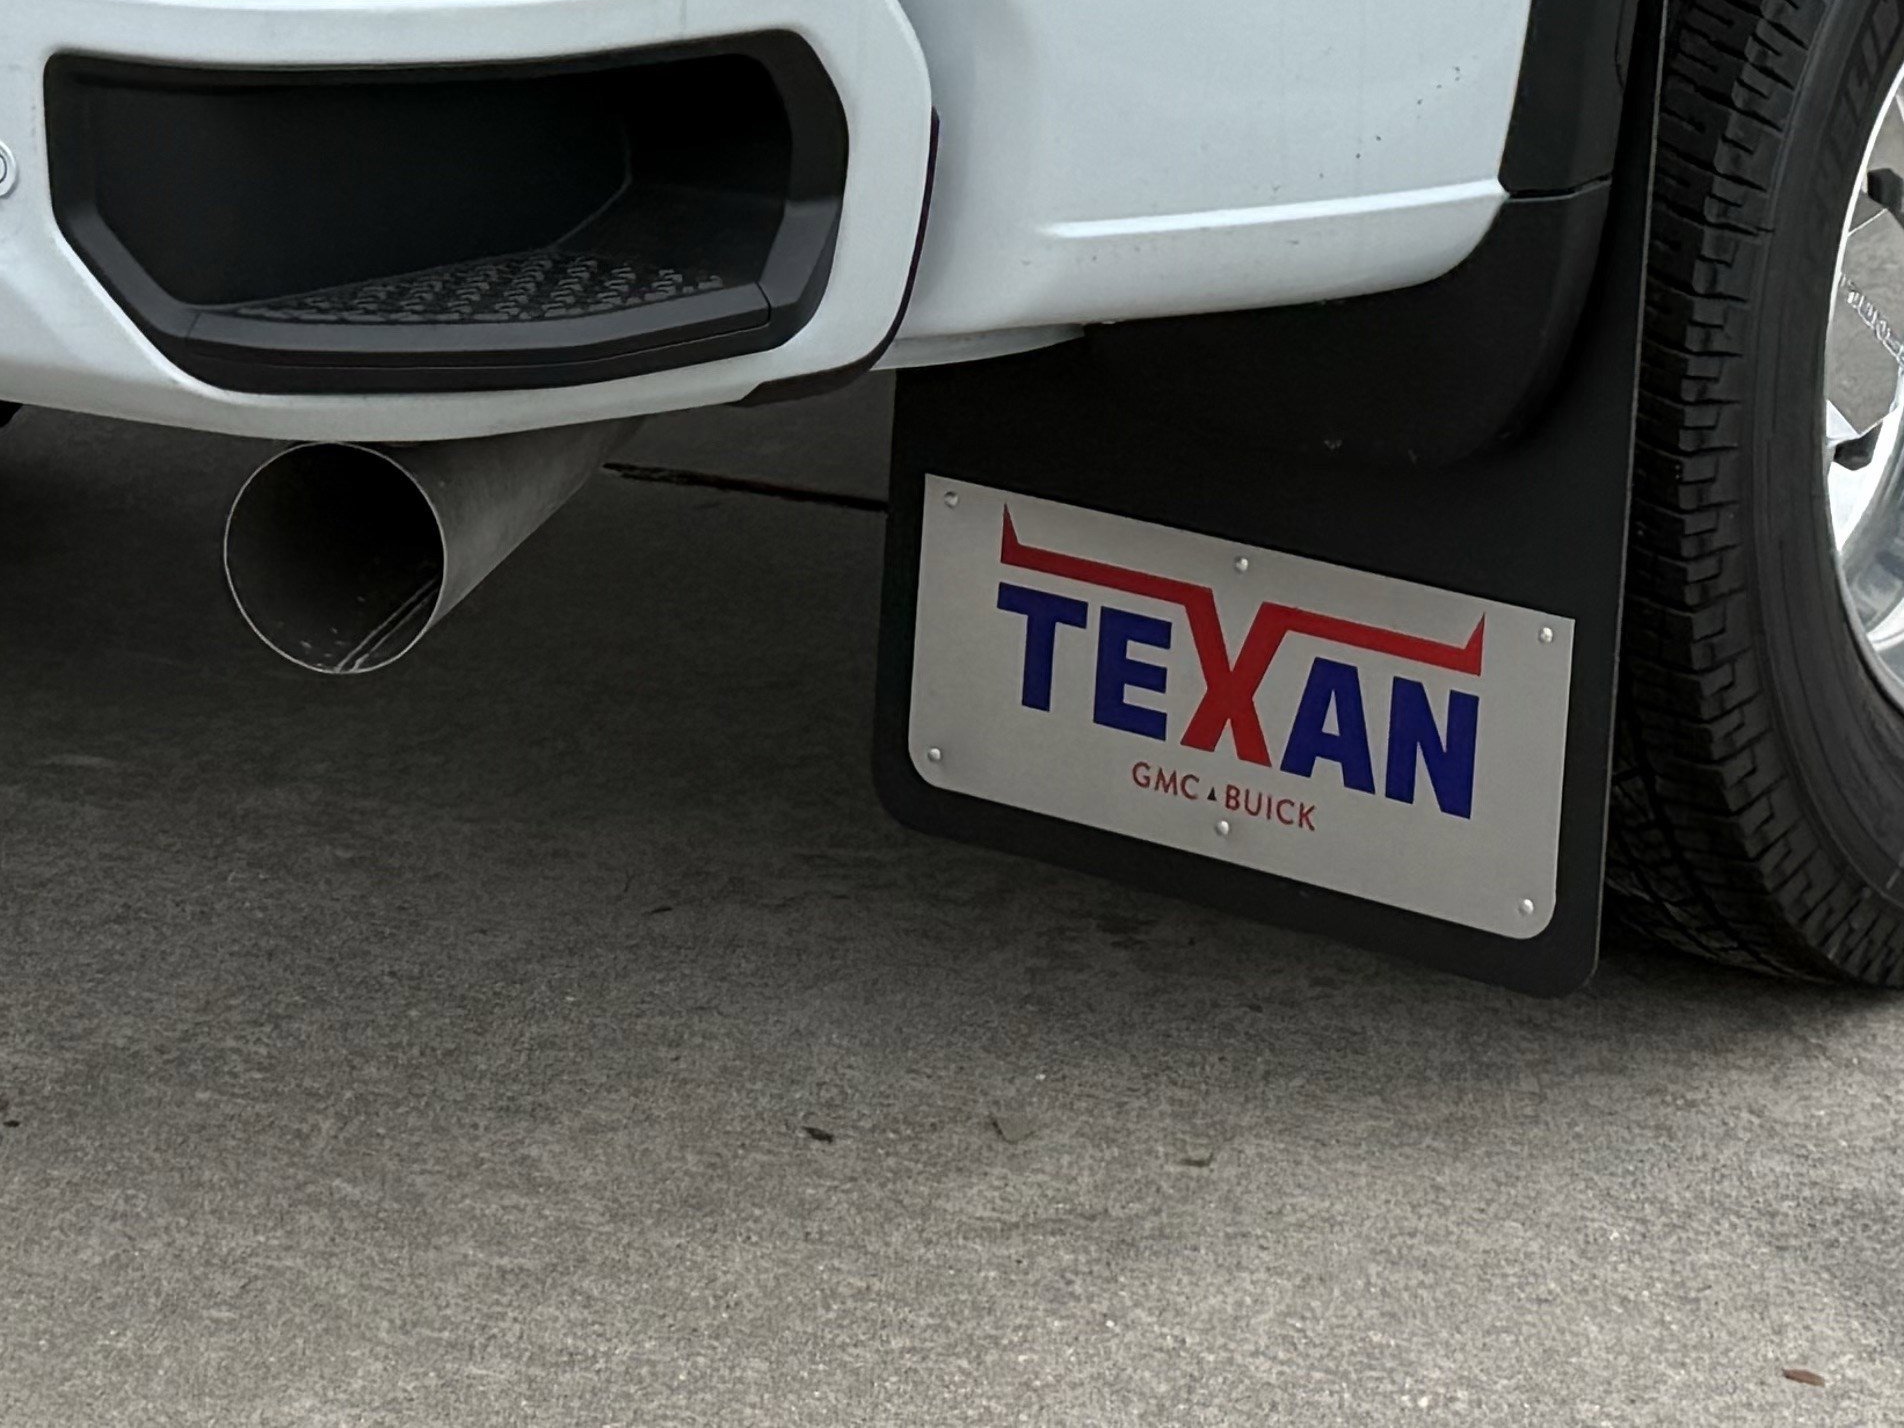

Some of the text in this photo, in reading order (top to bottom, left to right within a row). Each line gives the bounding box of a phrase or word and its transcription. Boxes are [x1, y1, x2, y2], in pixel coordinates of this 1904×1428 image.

[997, 502, 1486, 820] TEXAN
[1131, 761, 1316, 832] GMC BUICK
